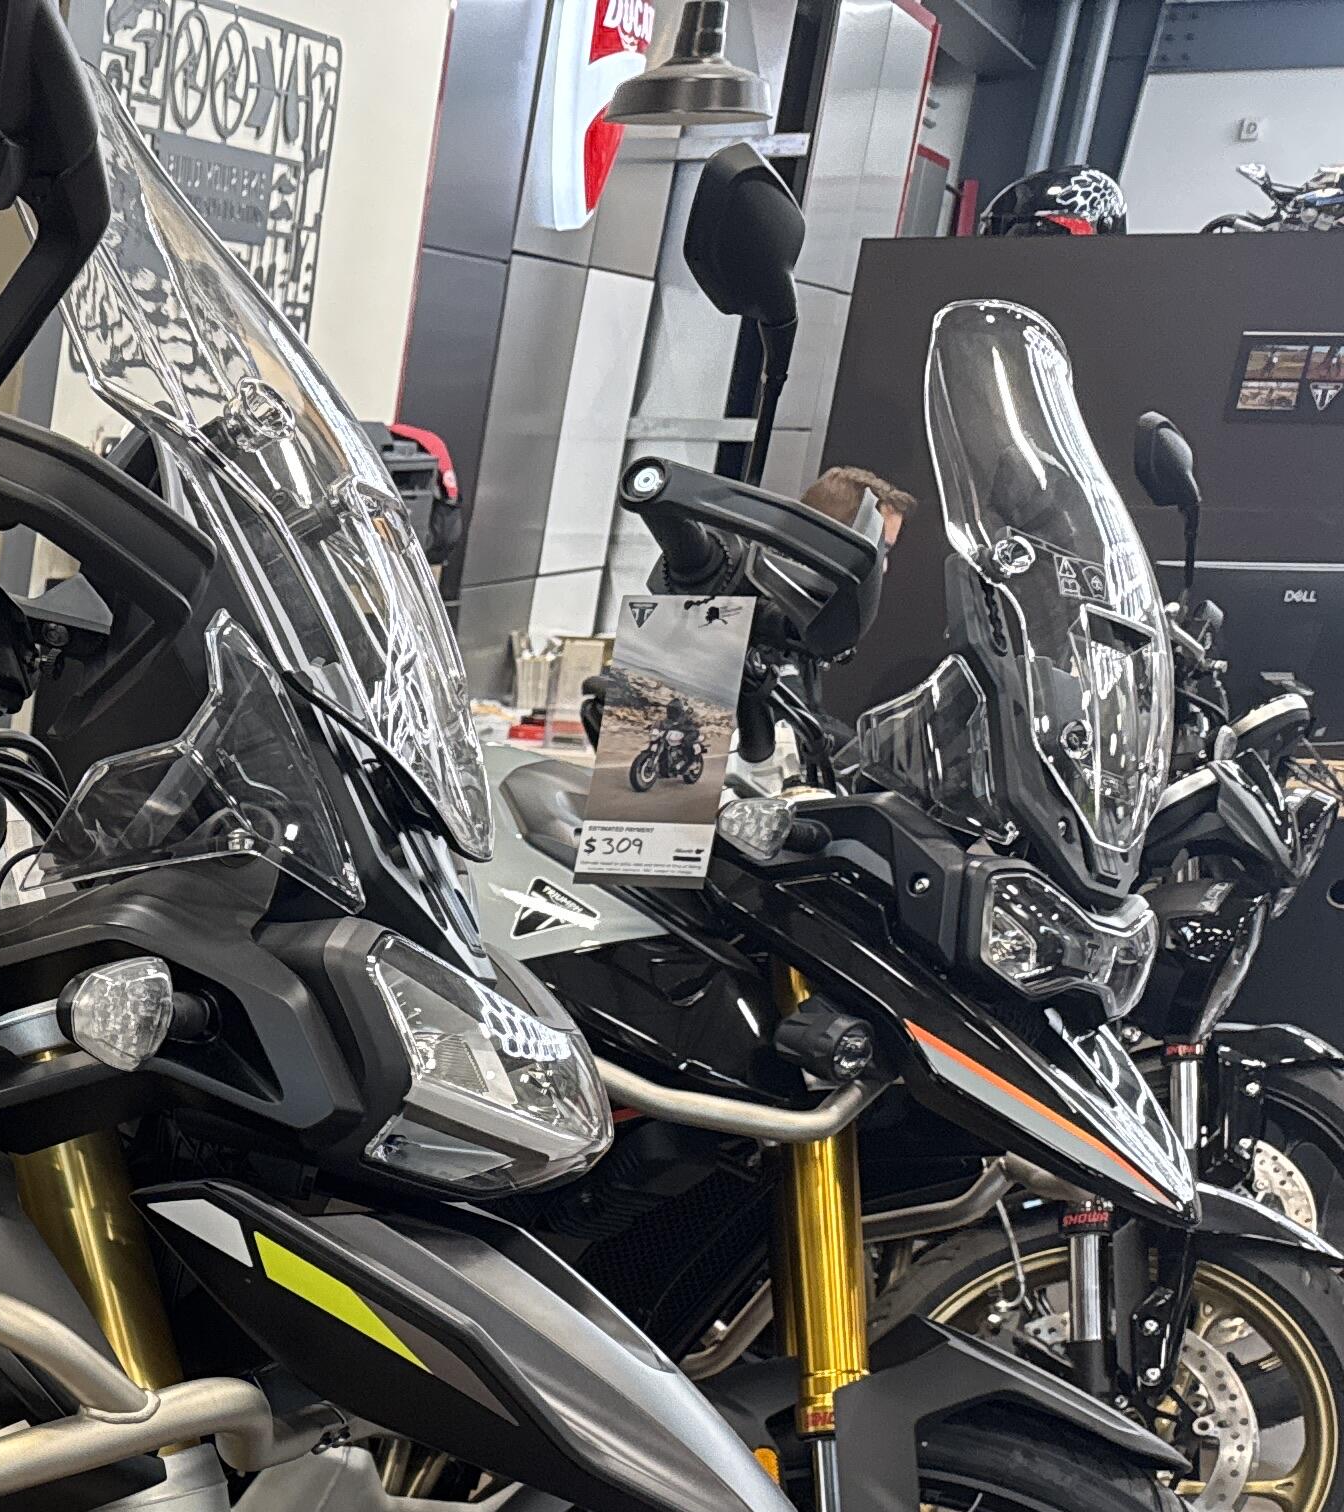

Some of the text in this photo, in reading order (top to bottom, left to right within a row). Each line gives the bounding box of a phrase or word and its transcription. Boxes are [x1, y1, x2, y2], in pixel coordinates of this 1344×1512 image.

[602, 0, 654, 44] DUCA
[1284, 590, 1317, 602] DELL
[543, 885, 584, 913] TRIUMPH
